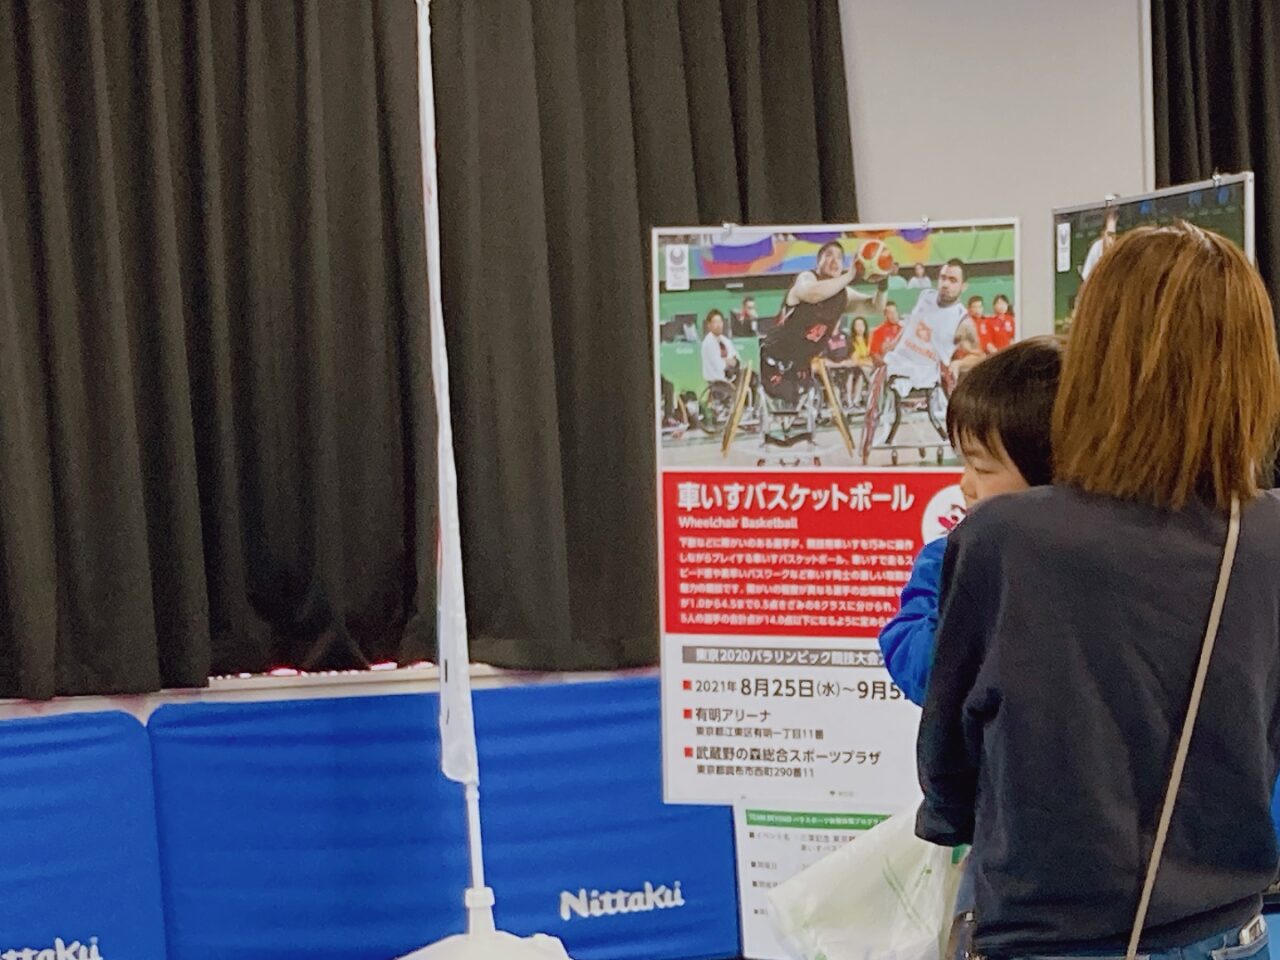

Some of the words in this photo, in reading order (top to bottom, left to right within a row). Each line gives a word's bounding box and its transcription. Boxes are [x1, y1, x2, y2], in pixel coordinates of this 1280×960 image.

[677, 482, 914, 512] 車いすバスケットボール
[678, 517, 739, 530] Wheelchair
[741, 517, 798, 530] Basketball
[695, 708, 771, 723] 有明アリーナ
[696, 746, 881, 766] 武蔵野の森総合スポーツプラザ
[560, 880, 686, 921] Nittaku
